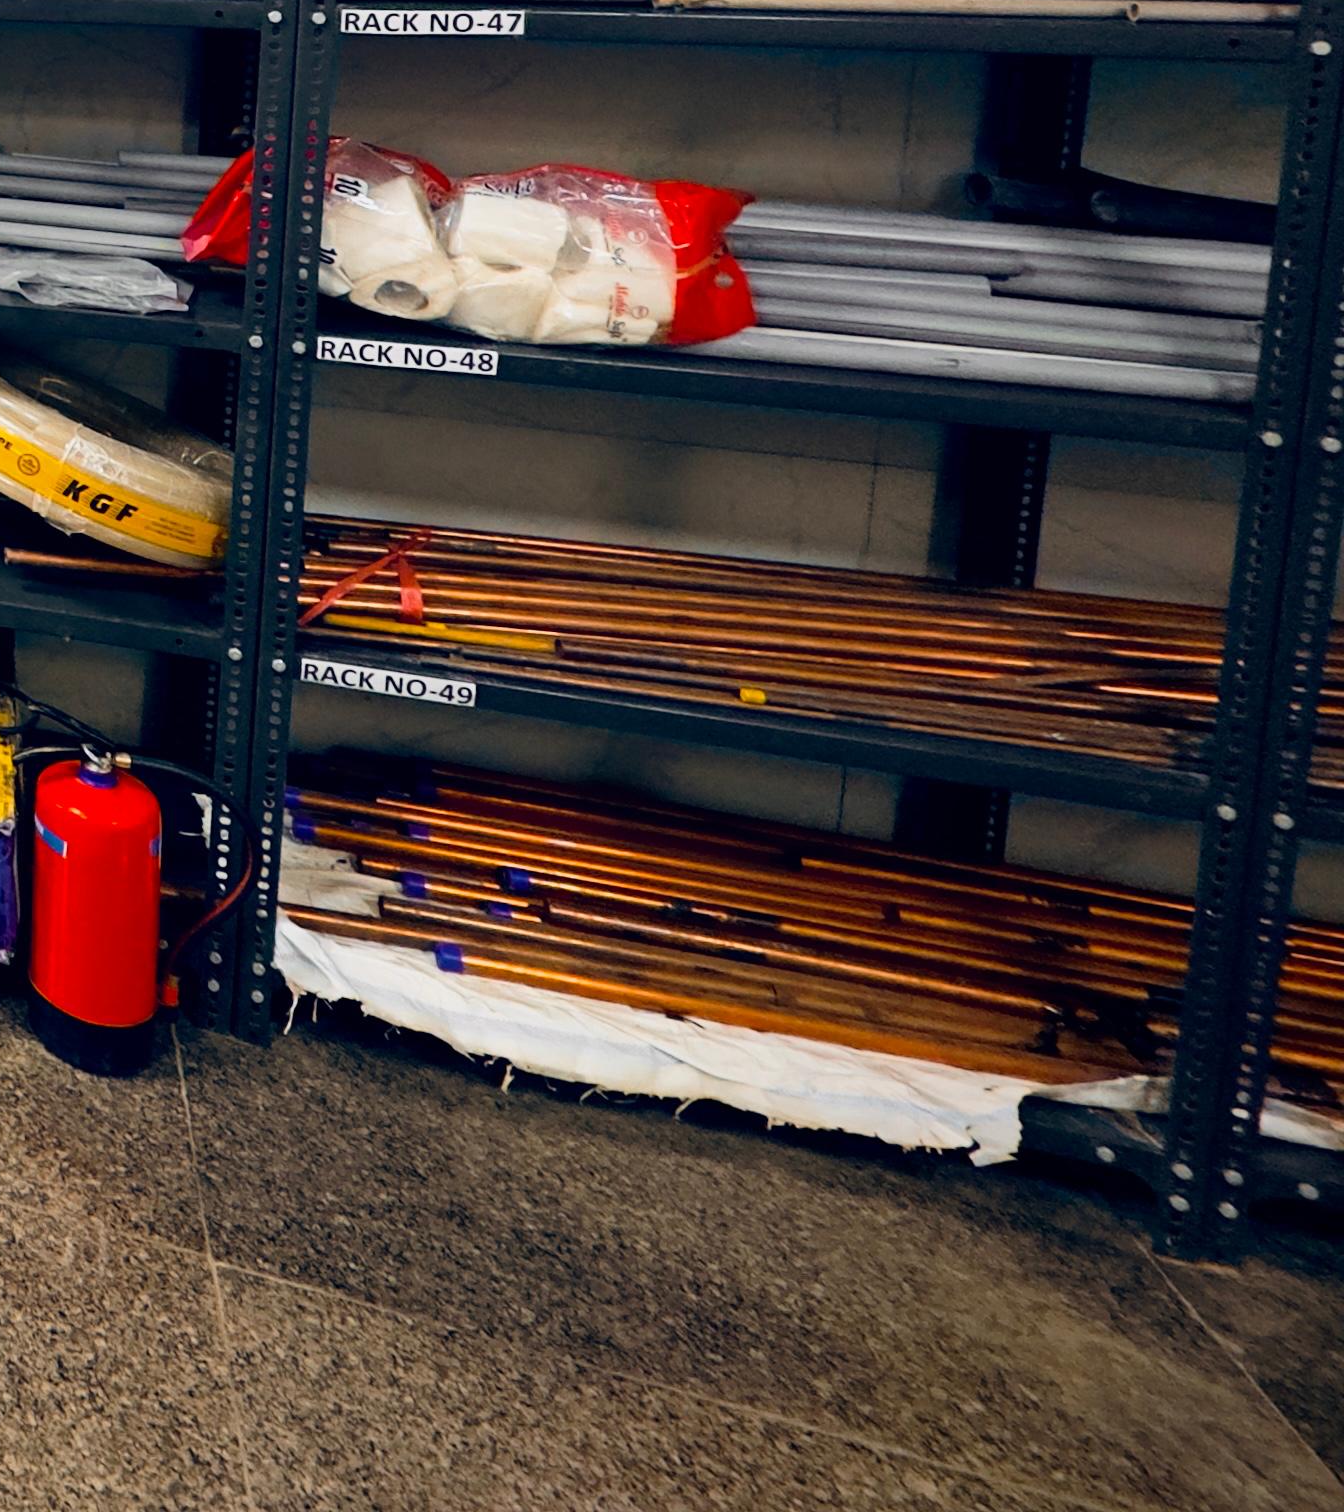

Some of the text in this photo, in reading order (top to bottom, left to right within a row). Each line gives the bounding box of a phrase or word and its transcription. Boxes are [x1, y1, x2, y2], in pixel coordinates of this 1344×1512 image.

[344, 12, 522, 33] RACK NO-47
[321, 342, 493, 372] RACK NO-48
[62, 479, 139, 522] KGF
[303, 663, 472, 705] RACK NO-49
